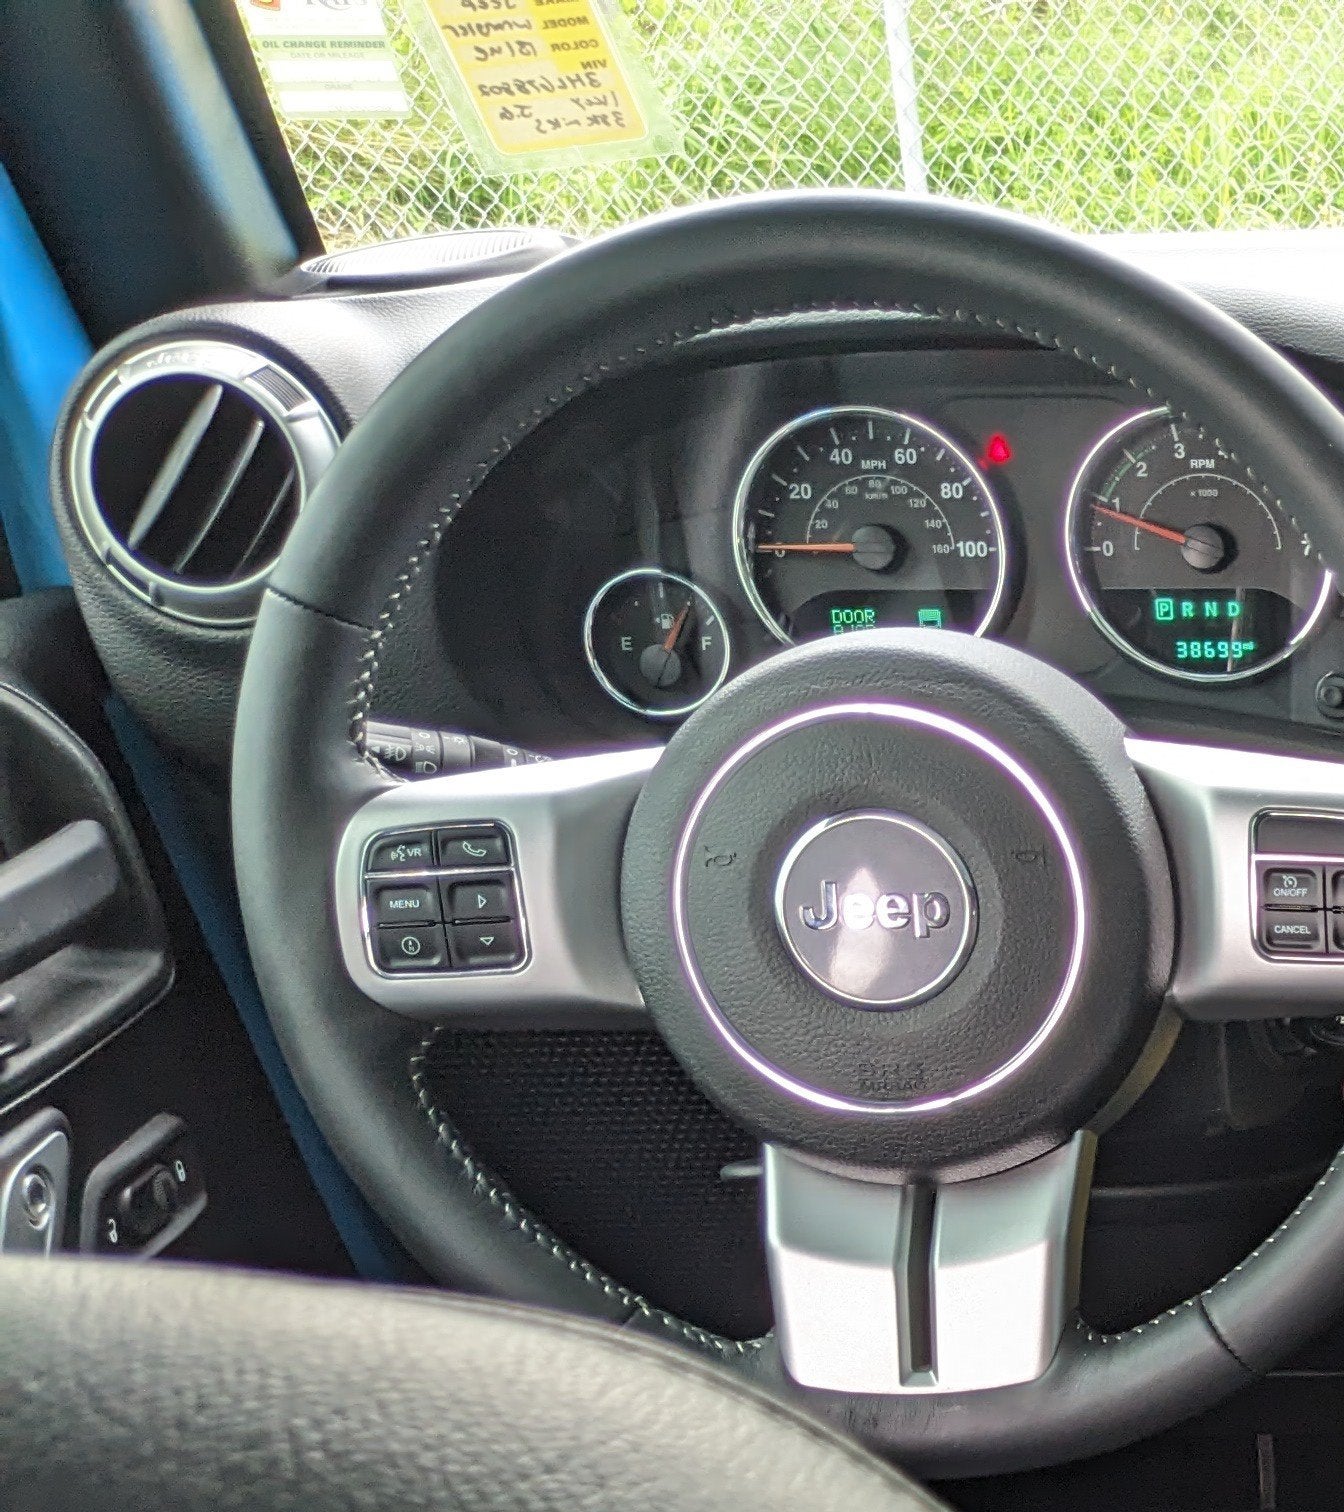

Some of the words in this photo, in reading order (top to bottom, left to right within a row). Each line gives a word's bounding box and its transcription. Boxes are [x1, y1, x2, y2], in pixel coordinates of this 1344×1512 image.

[262, 40, 279, 49] OIL
[283, 40, 327, 49] CHANGE
[330, 40, 385, 49] REMINDER
[829, 448, 853, 465] 40
[894, 448, 917, 465] 60
[1174, 443, 1185, 459] 3
[861, 460, 886, 470] MPH
[1136, 462, 1149, 477] 2
[1190, 459, 1215, 469] RPM
[789, 483, 812, 500] 20
[890, 485, 908, 495] 100
[940, 482, 963, 499] 80
[825, 500, 839, 509] 40
[909, 499, 927, 508] 120
[1112, 498, 1120, 513] 1
[815, 520, 828, 529] 20
[925, 520, 942, 529] 140
[957, 541, 988, 557] 100
[1102, 541, 1114, 557] 0
[831, 609, 875, 624] DOOR
[1181, 602, 1194, 618] R
[1204, 602, 1217, 617] N
[1228, 602, 1241, 617] D
[621, 637, 633, 651] E
[702, 637, 712, 651] F
[1176, 642, 1243, 659] 38699
[407, 847, 422, 858] VR
[1273, 887, 1308, 897] ON/OFF
[389, 899, 420, 909] MENU
[800, 879, 951, 938] Jeep
[1274, 925, 1311, 935] CANCEL
